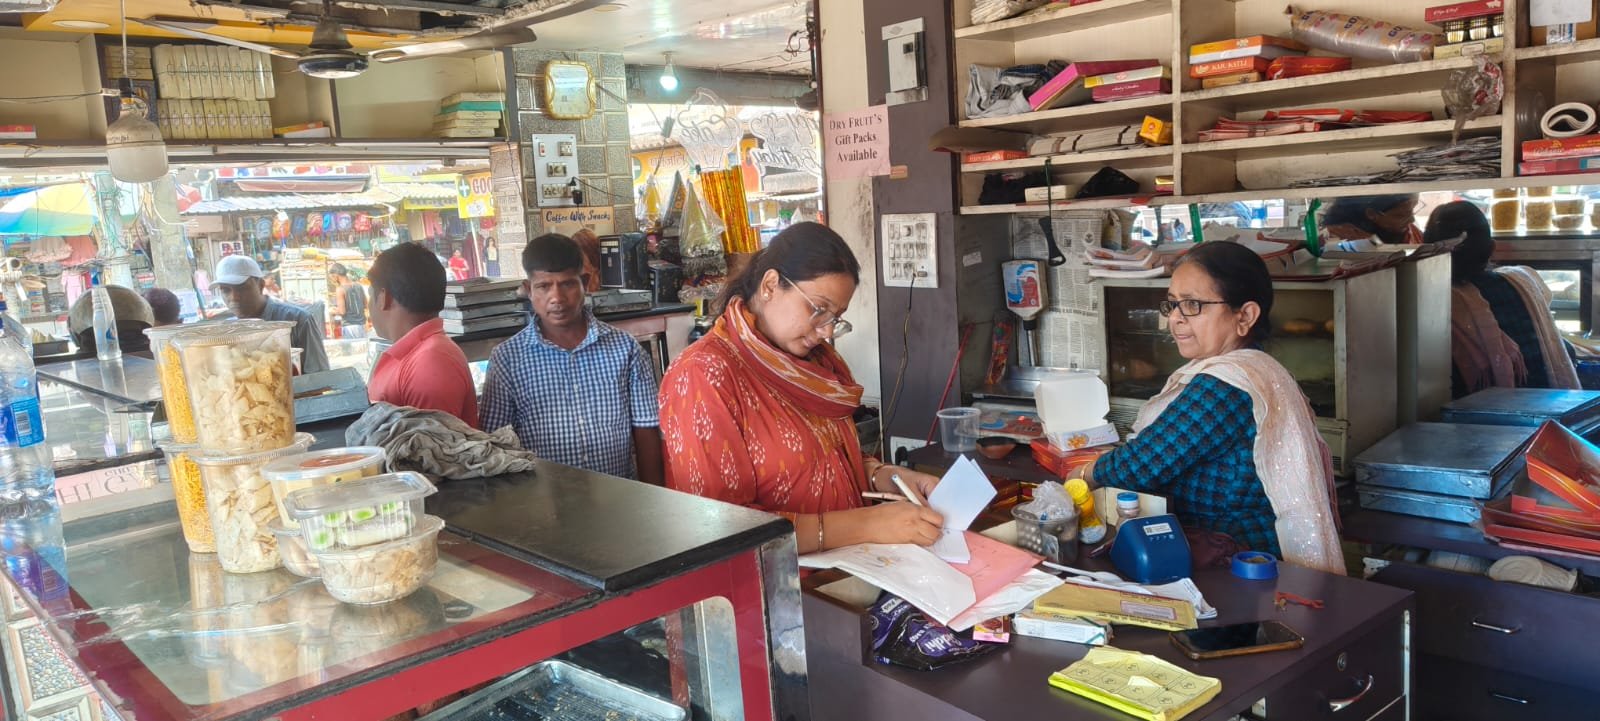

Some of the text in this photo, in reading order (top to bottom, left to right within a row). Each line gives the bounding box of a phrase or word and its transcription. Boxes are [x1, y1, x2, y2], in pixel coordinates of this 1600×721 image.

[829, 113, 883, 131] DRY FRUIT'S
[835, 132, 877, 145] Gift Packs
[837, 148, 878, 163] Available
[546, 211, 568, 223] Coffee
[570, 210, 586, 222] With
